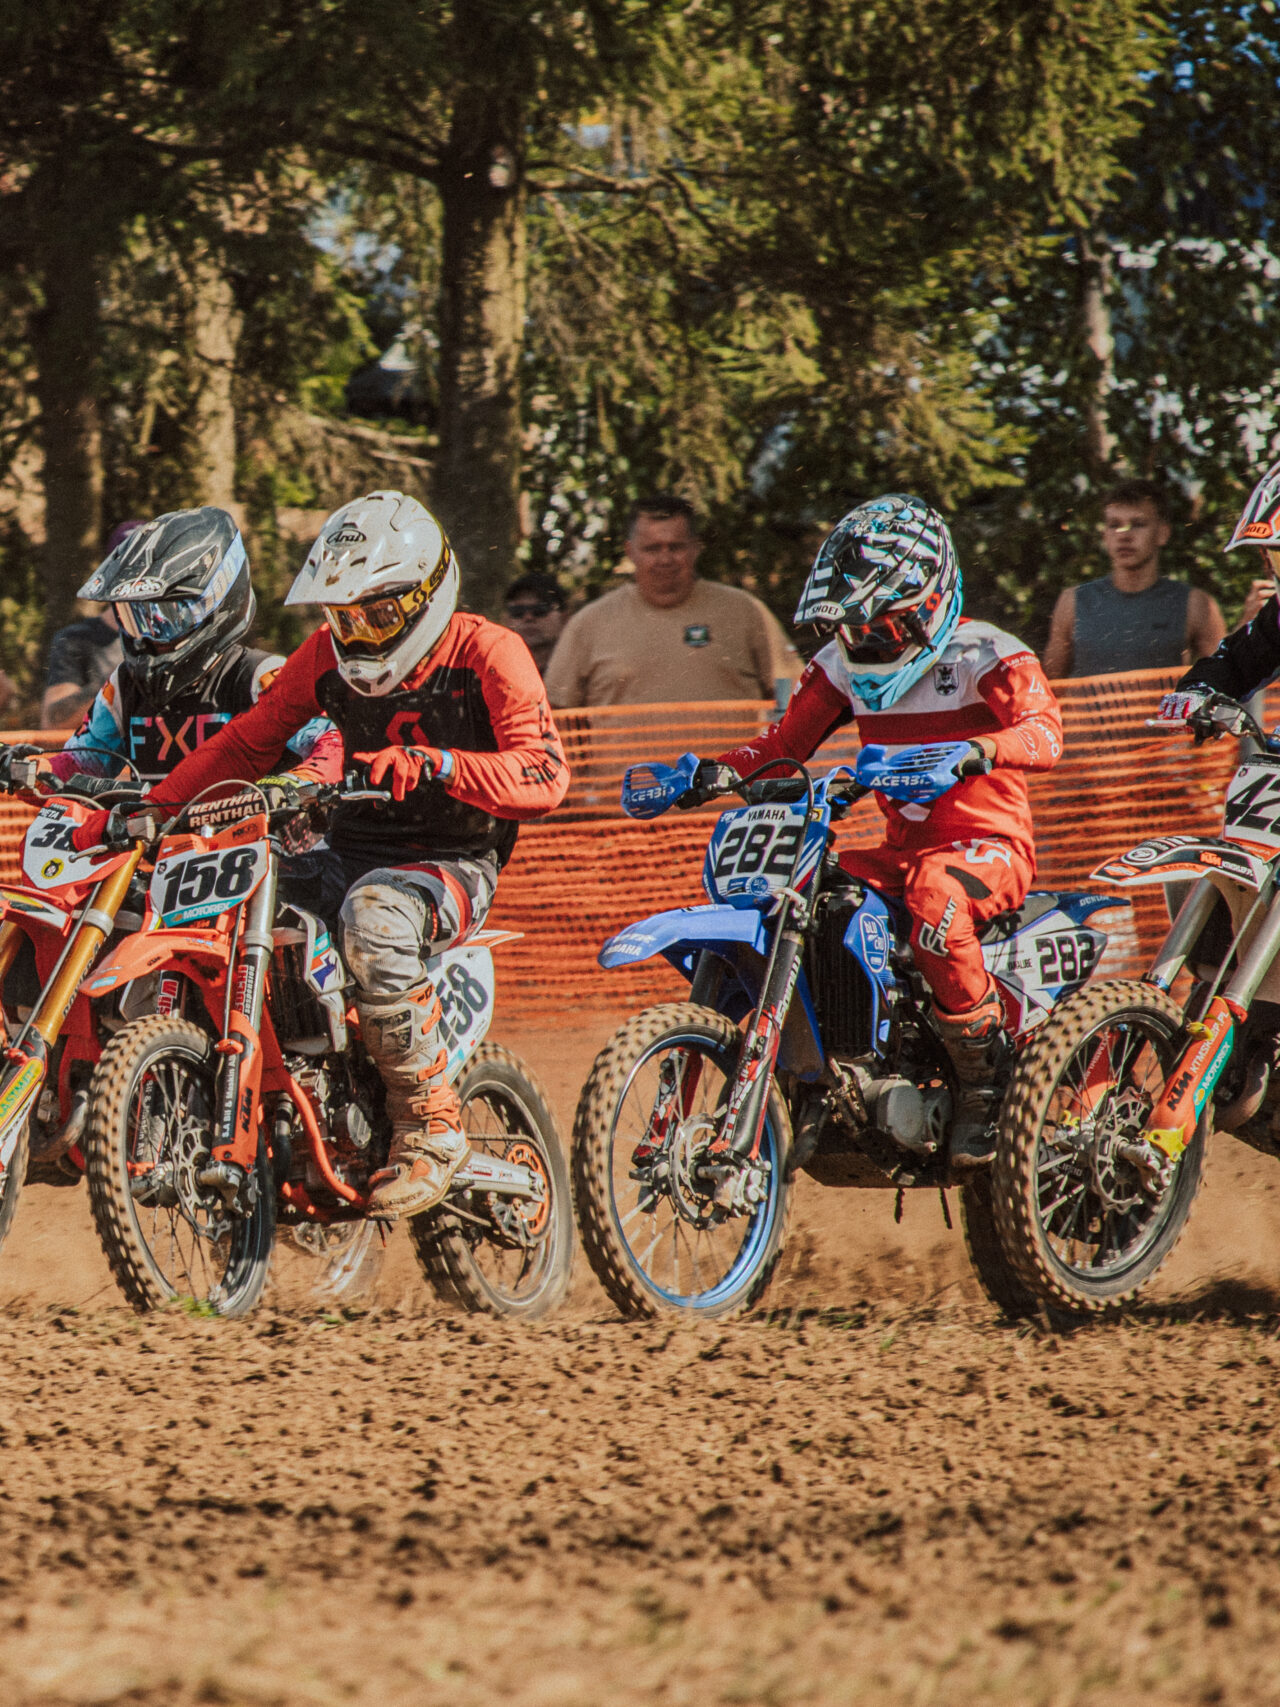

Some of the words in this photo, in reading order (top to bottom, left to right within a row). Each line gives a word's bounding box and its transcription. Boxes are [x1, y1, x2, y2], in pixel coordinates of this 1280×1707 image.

[326, 531, 368, 545] Arai
[810, 605, 839, 616] SHOEI
[188, 793, 263, 816] RENTHAL
[189, 803, 264, 828] RENTHAL
[747, 809, 786, 822] YAMAHA
[715, 824, 803, 878] 282
[162, 847, 258, 915] 158
[183, 902, 232, 919] MOTOREX
[1035, 933, 1095, 984] 282
[1202, 1041, 1230, 1089] MOTOREX
[1167, 1071, 1193, 1111] KTM
[241, 1087, 253, 1133] KTM
